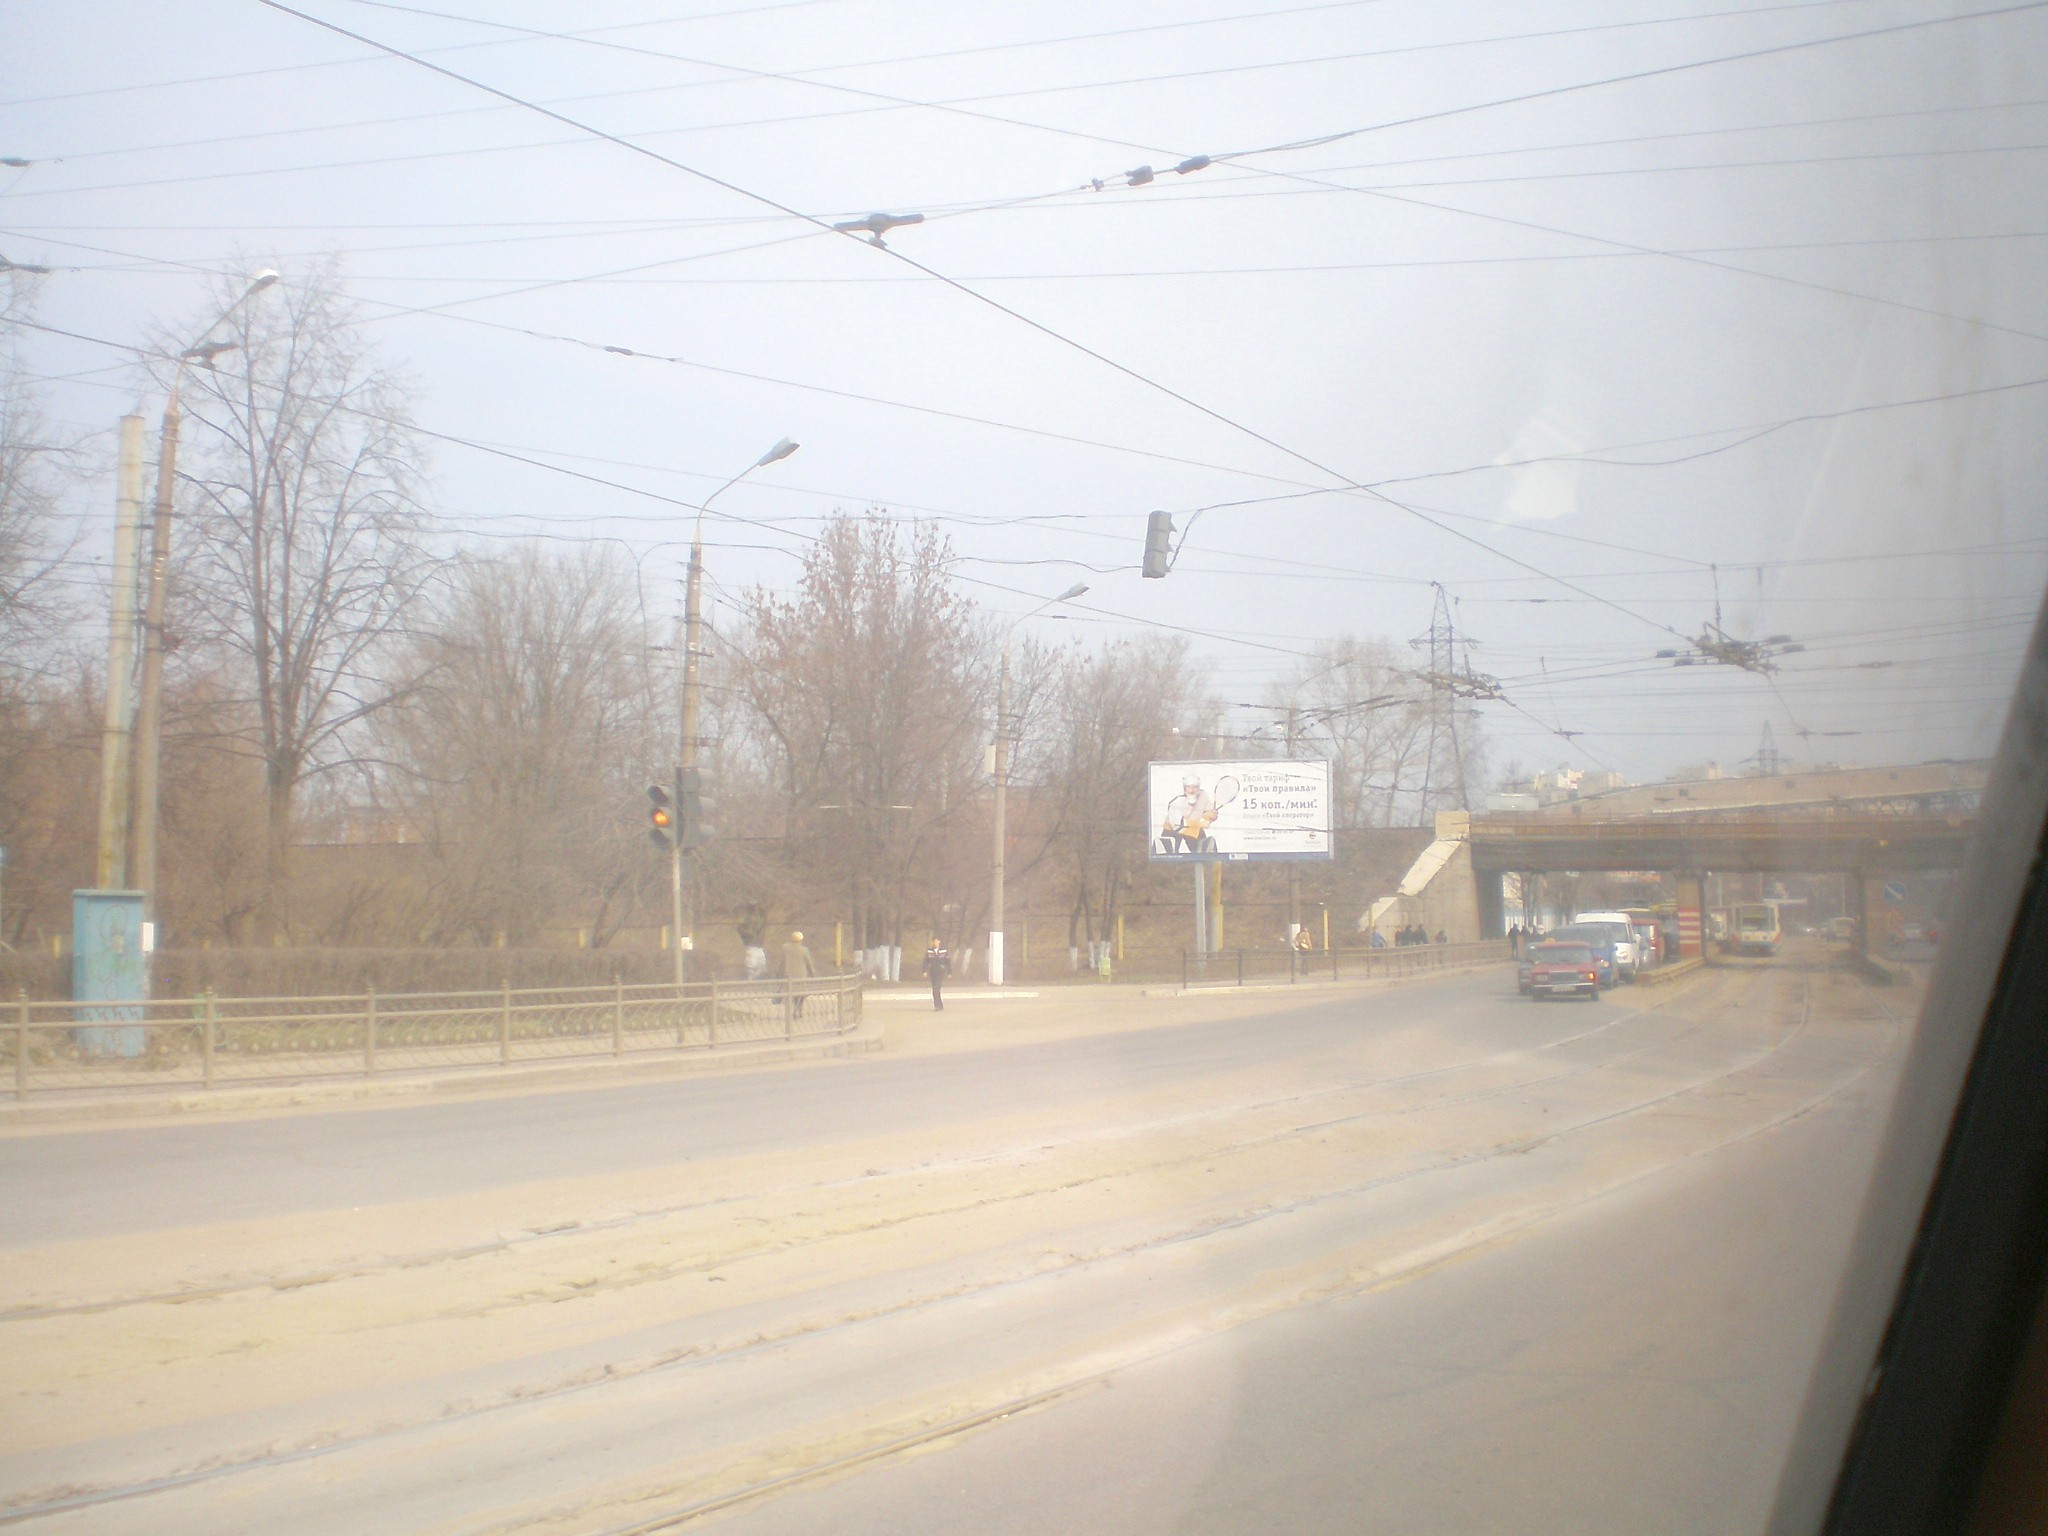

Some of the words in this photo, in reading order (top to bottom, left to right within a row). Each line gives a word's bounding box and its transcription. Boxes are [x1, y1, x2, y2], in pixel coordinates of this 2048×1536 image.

[1264, 773, 1290, 783] тариф
[1272, 785, 1317, 794] правила»
[1242, 798, 1258, 809] 15
